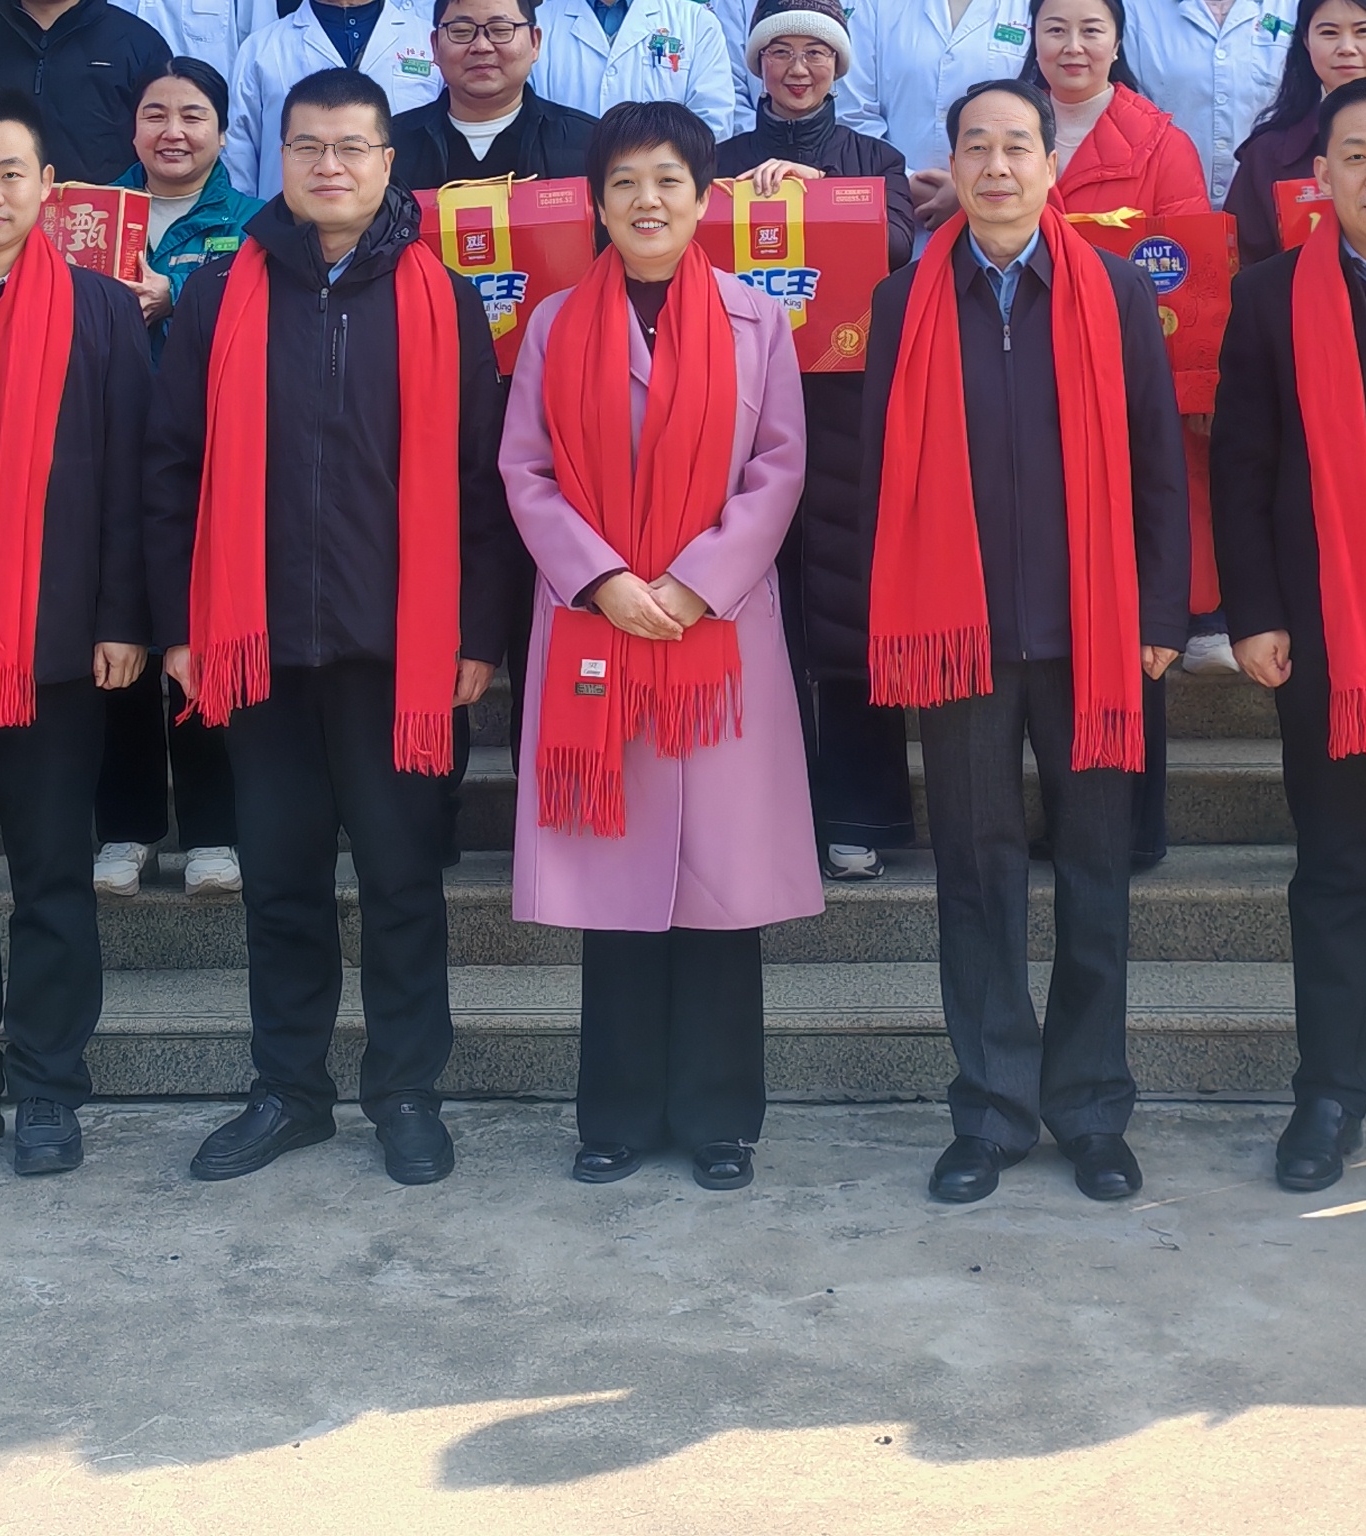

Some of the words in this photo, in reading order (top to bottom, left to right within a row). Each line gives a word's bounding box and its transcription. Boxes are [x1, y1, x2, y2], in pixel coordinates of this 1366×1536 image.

[65, 203, 110, 268] 甄
[1142, 245, 1173, 258] NUT
[493, 302, 512, 313] King
[783, 298, 802, 309] King
